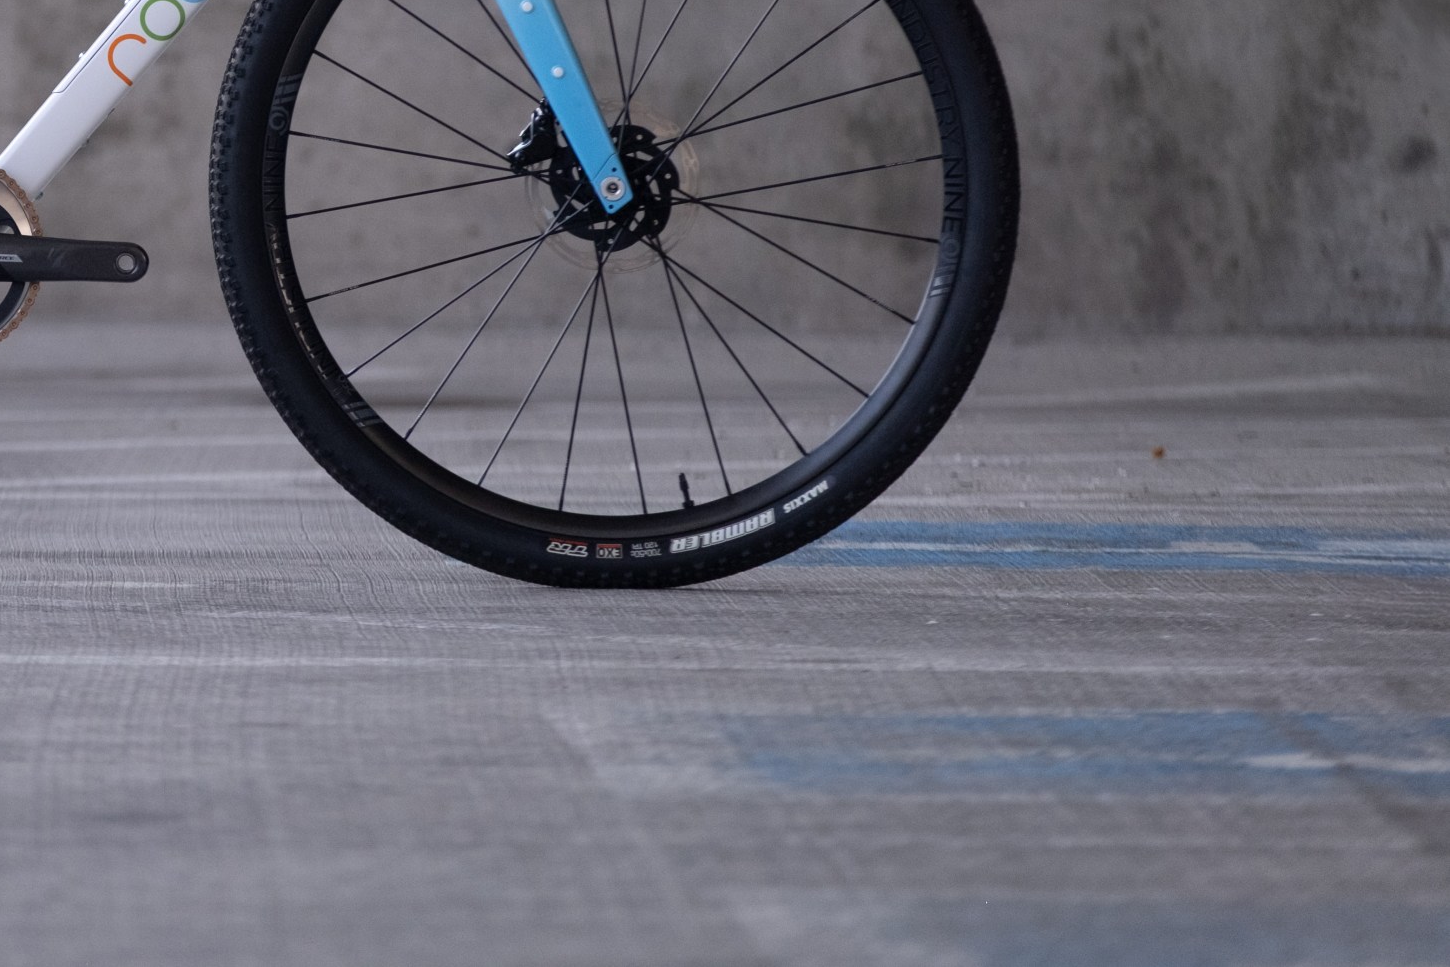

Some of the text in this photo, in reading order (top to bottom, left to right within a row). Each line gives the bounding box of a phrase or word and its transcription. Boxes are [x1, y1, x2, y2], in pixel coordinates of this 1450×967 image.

[263, 135, 286, 209] NINE
[942, 157, 964, 233] NINE
[783, 480, 829, 514] MAXXIS
[597, 546, 622, 558] EXO
[670, 508, 776, 553] RAMBLER
